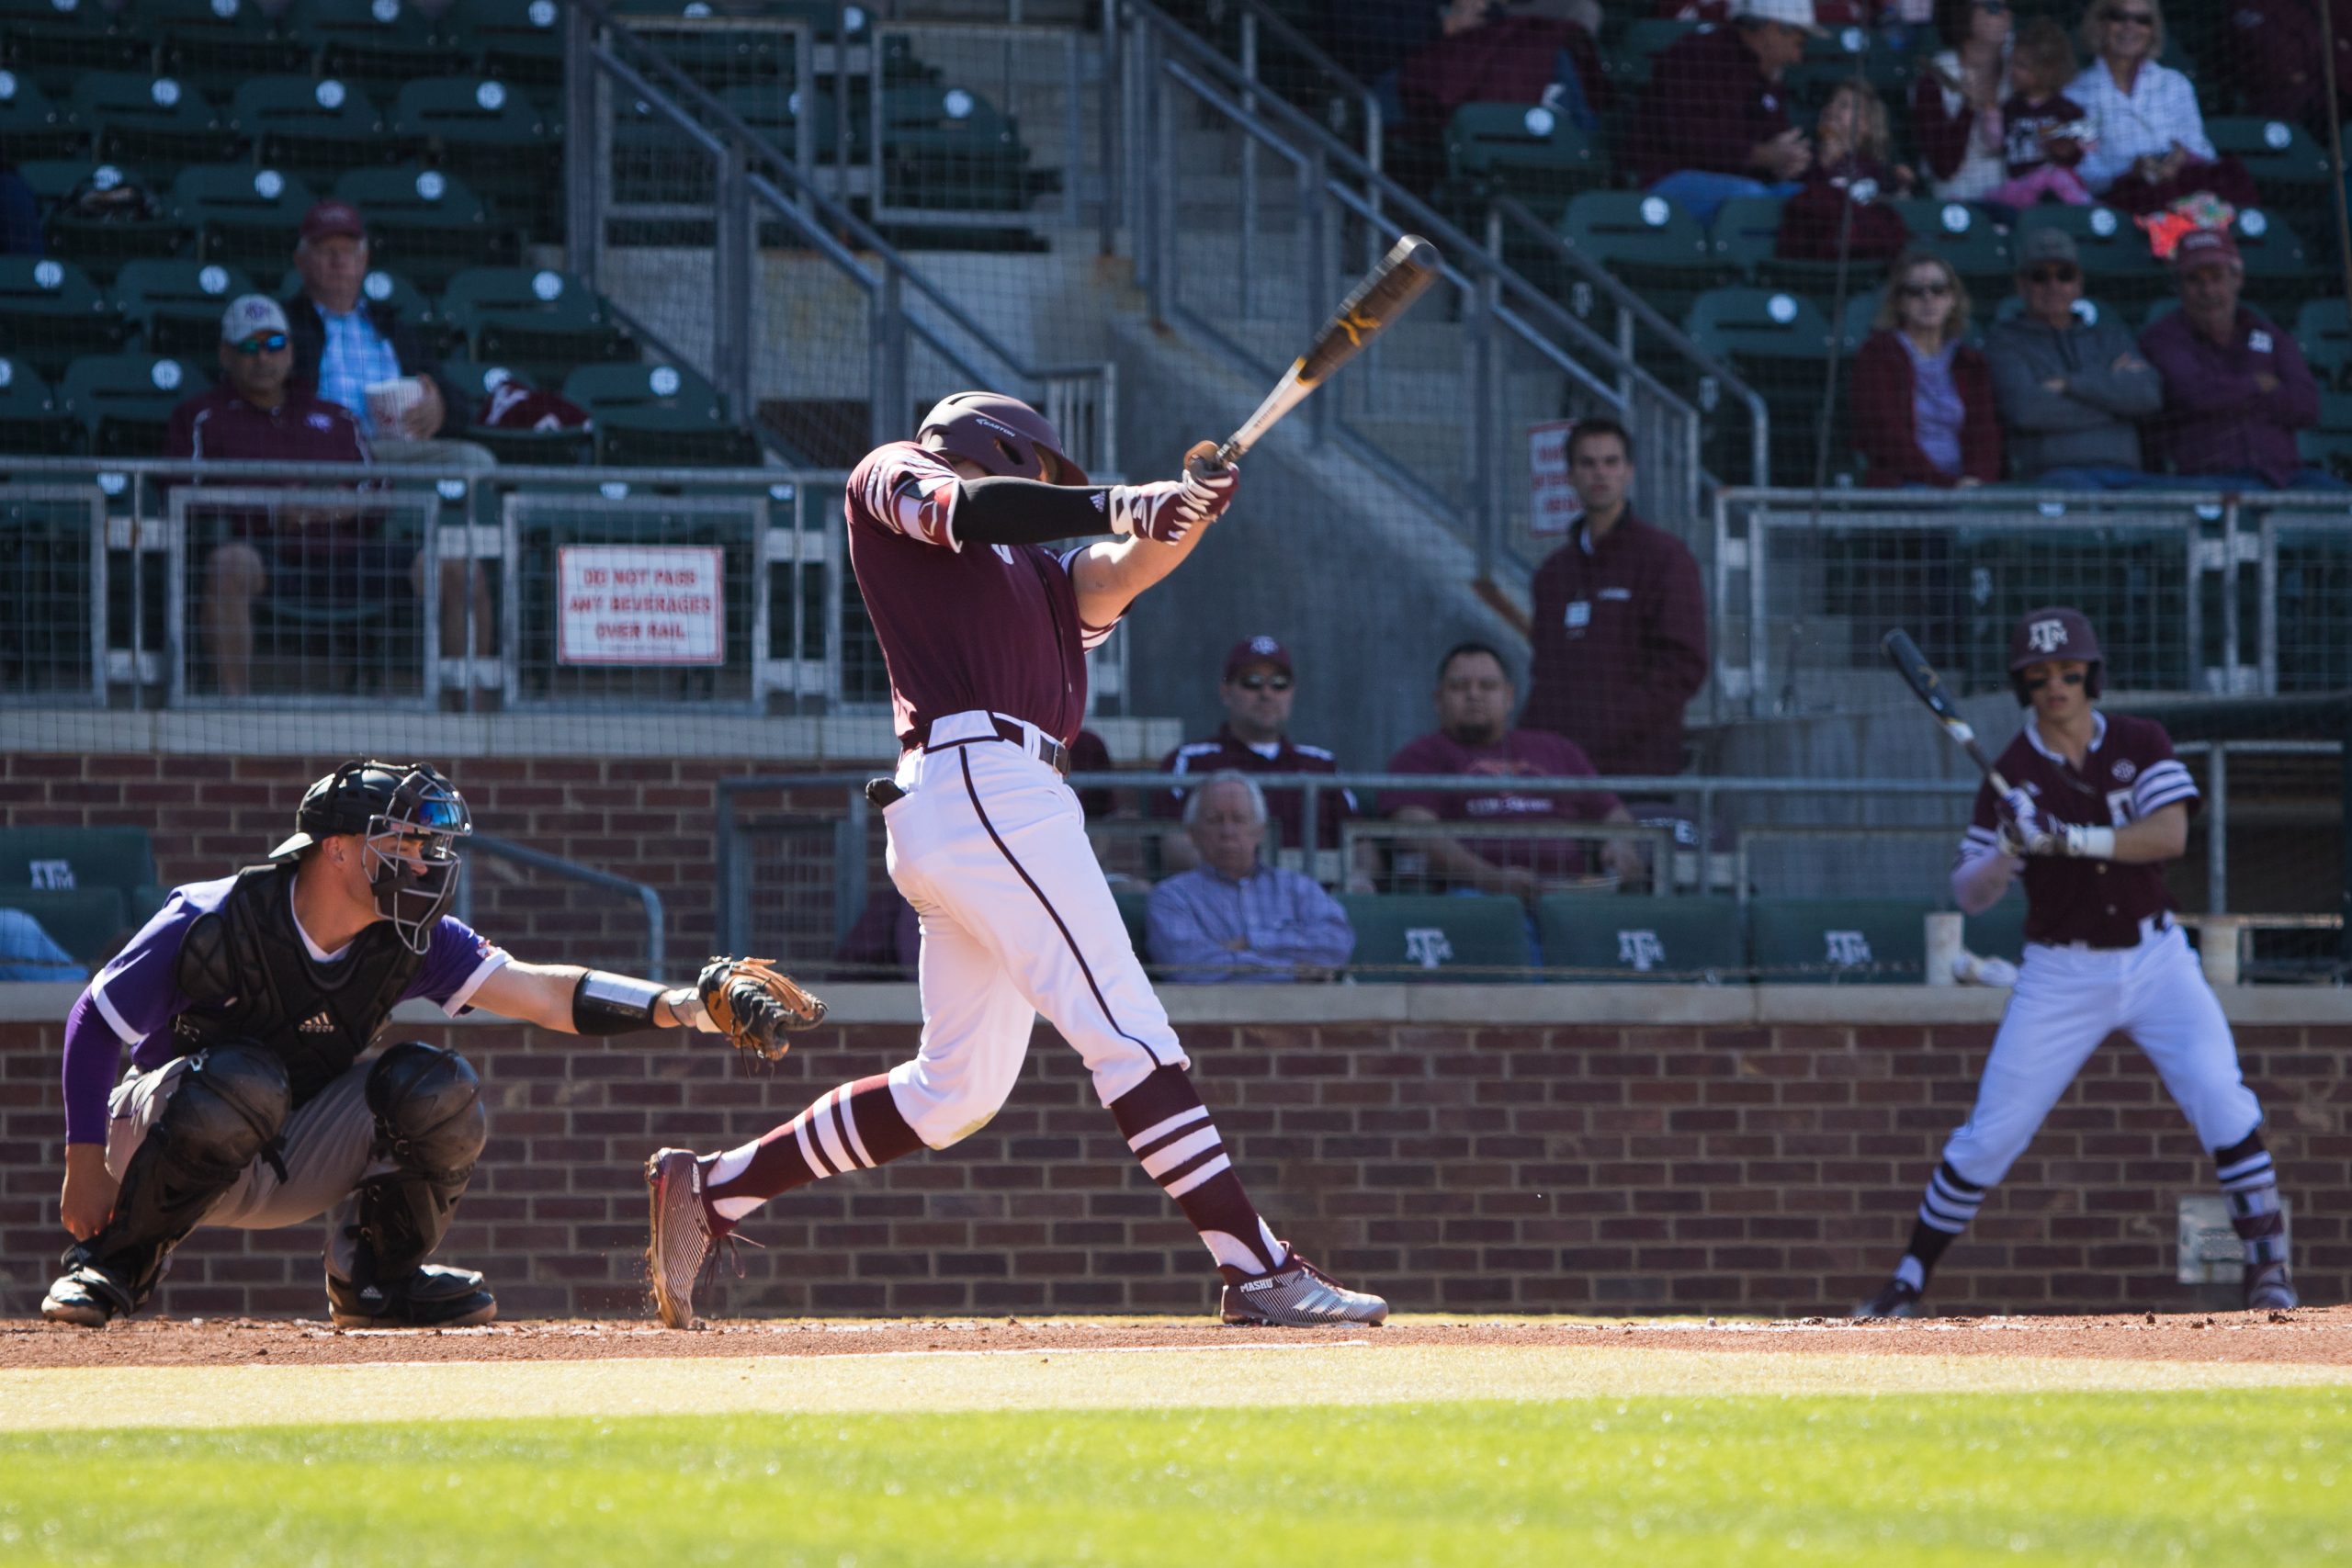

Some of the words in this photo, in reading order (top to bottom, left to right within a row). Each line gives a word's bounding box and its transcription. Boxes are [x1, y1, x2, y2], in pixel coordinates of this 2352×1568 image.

[983, 420, 1016, 437] EASTON
[583, 568, 606, 586] DO
[614, 568, 648, 586] NOT
[655, 569, 695, 586] PASS
[571, 596, 604, 613] ANY
[610, 596, 711, 614] BEVERAGES
[595, 622, 641, 639] OVER
[647, 622, 686, 639] RAIL
[1239, 1277, 1274, 1293] MASHU
